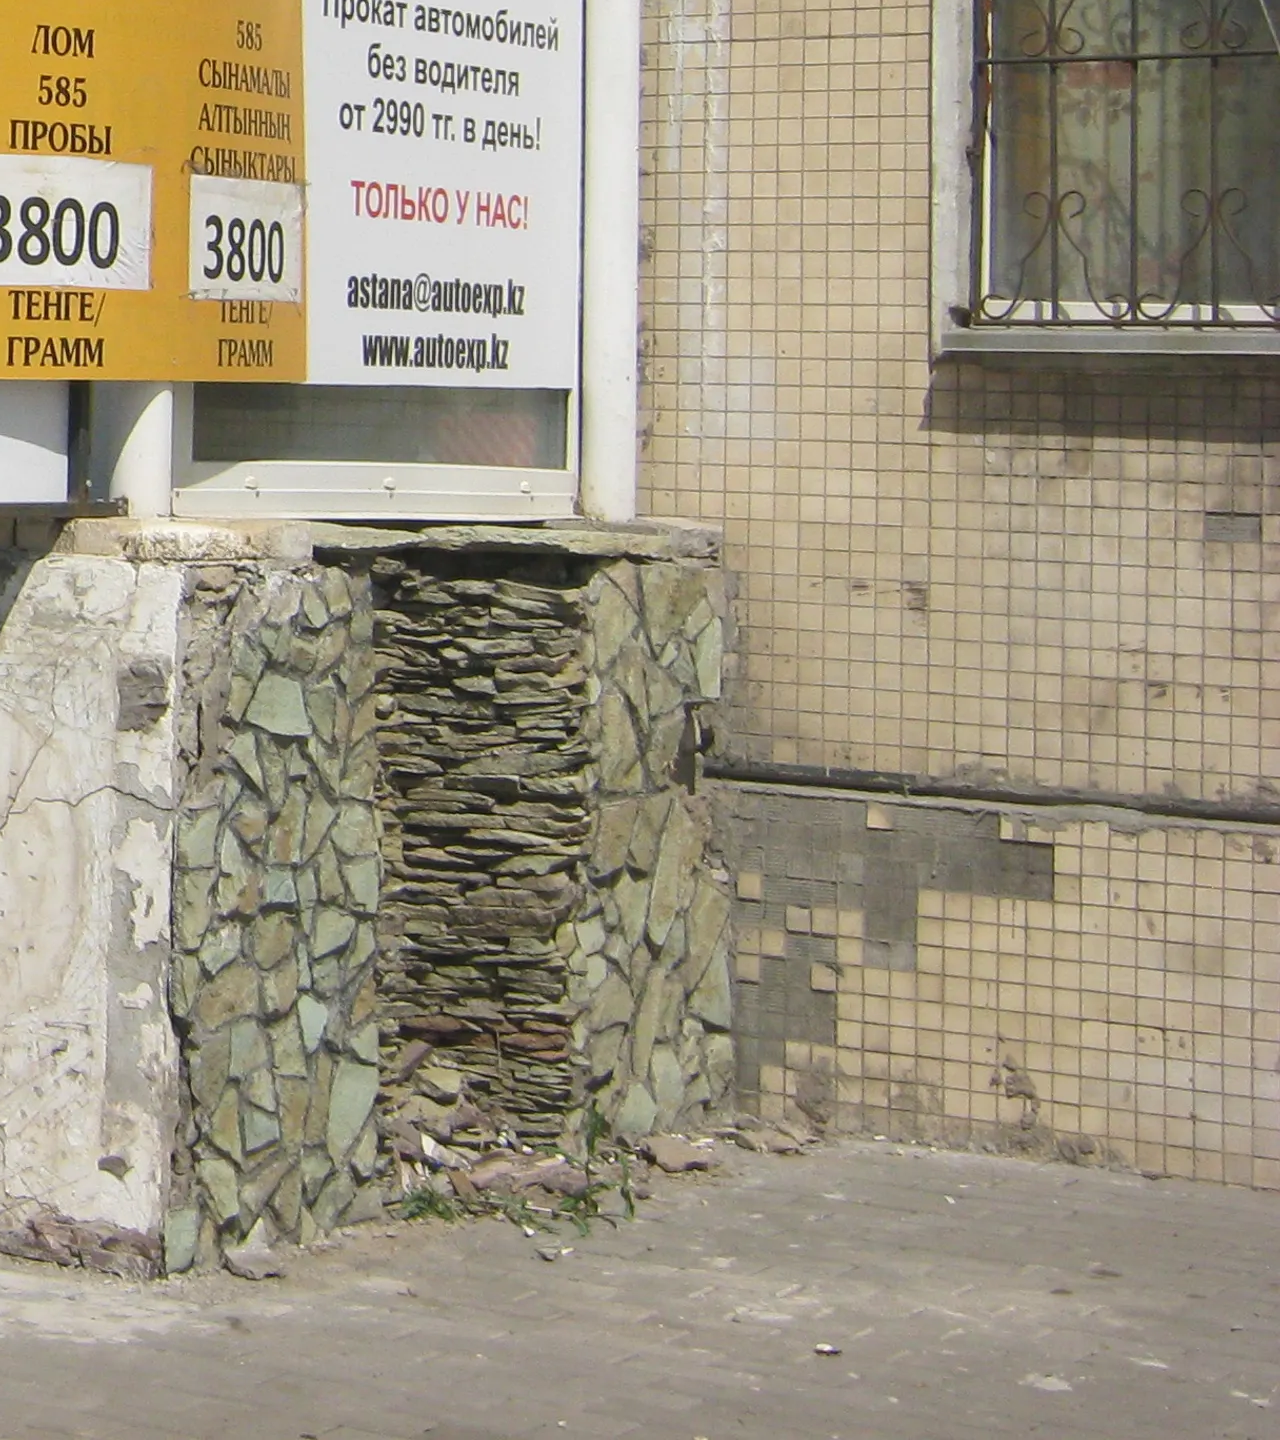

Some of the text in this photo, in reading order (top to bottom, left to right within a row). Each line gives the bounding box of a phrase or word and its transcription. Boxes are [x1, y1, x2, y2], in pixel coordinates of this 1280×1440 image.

[31, 24, 95, 59] ЛОМ
[236, 20, 262, 51] 585
[414, 4, 559, 51] автомобилей
[199, 58, 291, 99] СЫНАМАЛЫ
[367, 42, 520, 97] без водителя
[38, 75, 87, 108] 585
[9, 120, 112, 155] ПРОБЫ
[198, 103, 292, 143] АЛТЫННЫҢ
[339, 97, 542, 152] от 2990 тг. в день!
[350, 180, 528, 230] ТОЛЬКО У НАС!
[203, 214, 284, 285] 3800
[8, 290, 106, 327] ТЕНГЕ/
[347, 273, 525, 318] astana@autoexp.kz
[6, 336, 104, 368] ГРАММ
[217, 339, 274, 368] ГРАММ
[362, 333, 509, 373] www.autoexp.kz
